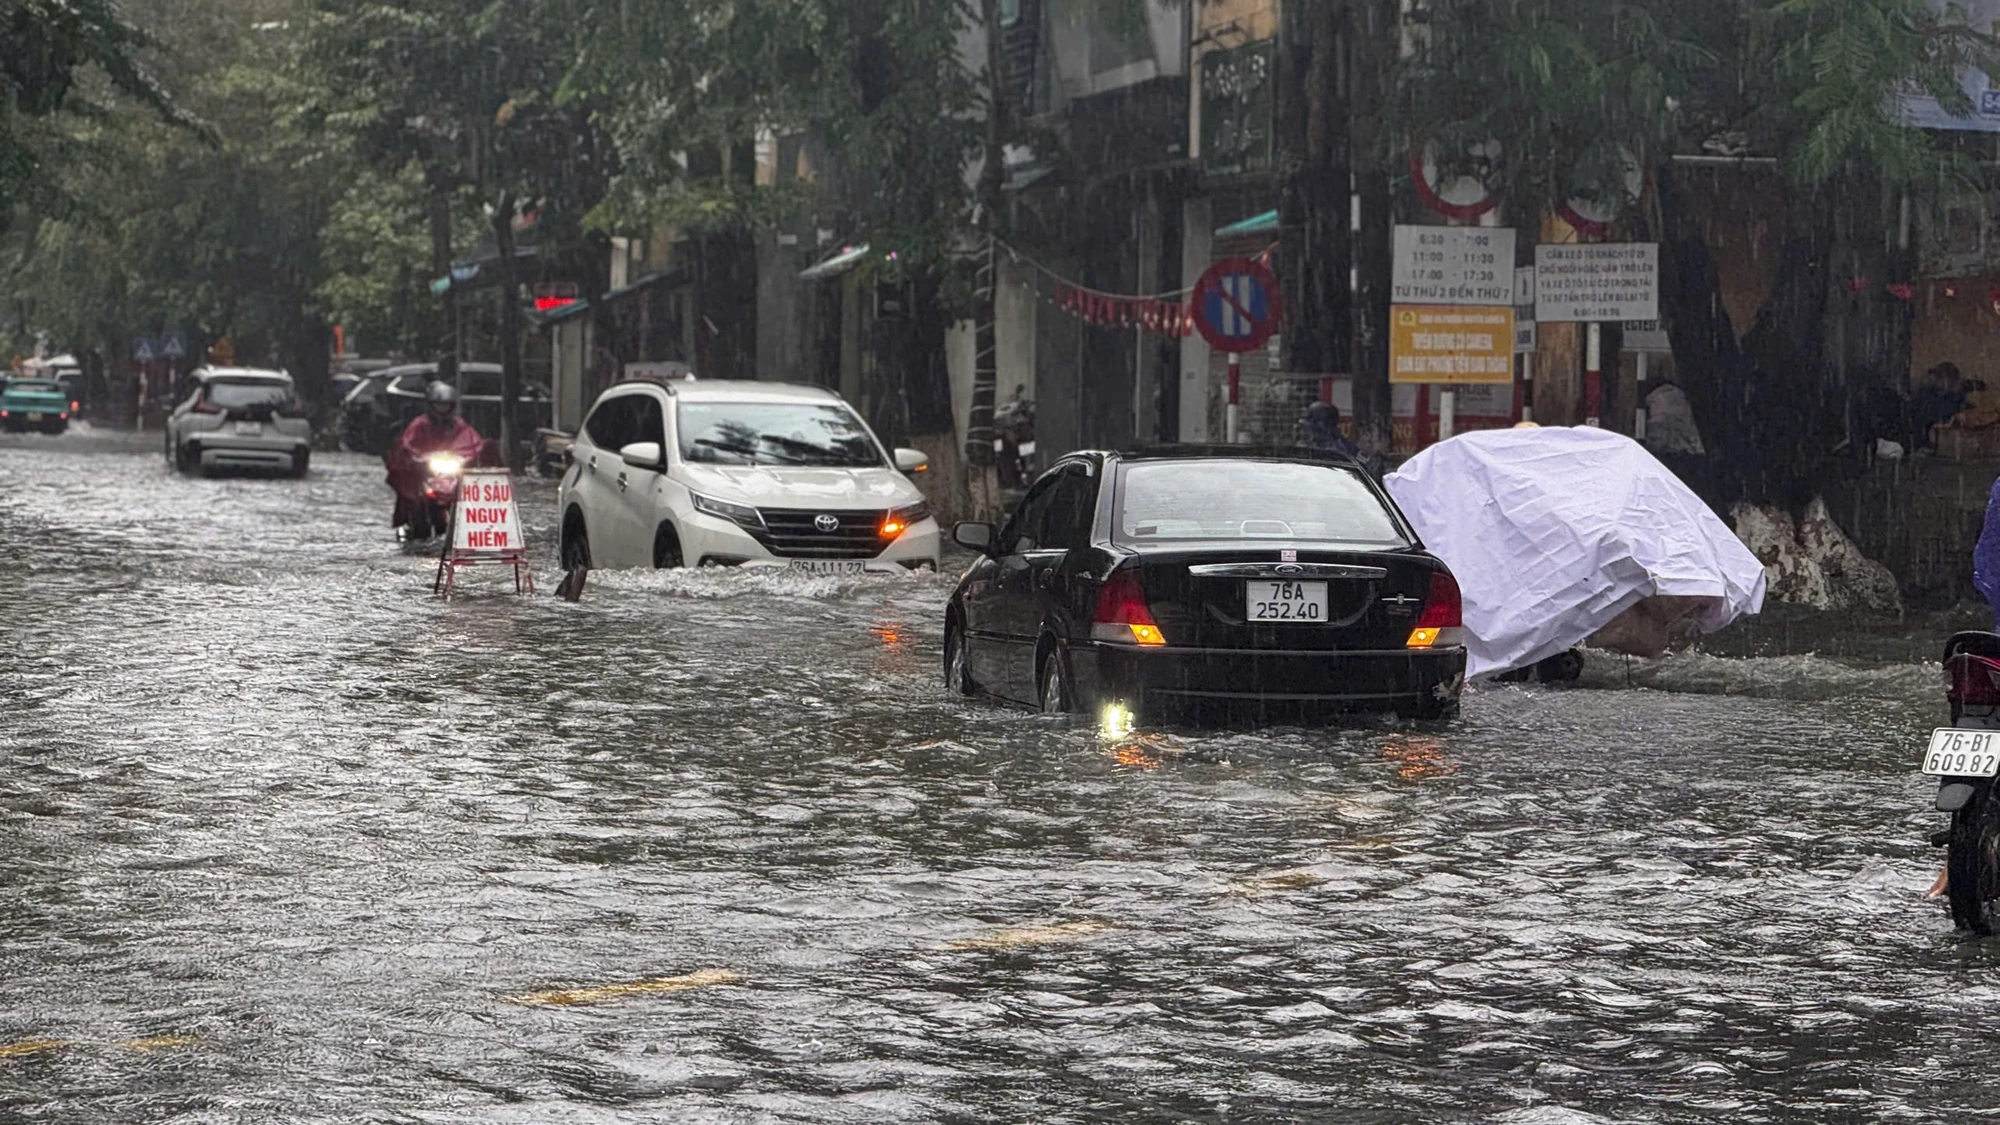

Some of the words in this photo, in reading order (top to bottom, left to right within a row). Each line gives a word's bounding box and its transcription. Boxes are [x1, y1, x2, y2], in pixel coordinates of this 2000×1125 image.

[1413, 252, 1444, 262] 11:00
[1464, 253, 1494, 264] 11:30
[1412, 269, 1443, 280] 17:00
[1464, 271, 1494, 281] 17:30
[1440, 287, 1446, 297] 2
[1503, 289, 1511, 299] 7
[463, 478, 480, 502] HỐ
[484, 480, 509, 502] SÂU
[466, 508, 507, 523] NGUY
[468, 525, 508, 547] HIỂM
[1270, 583, 1304, 600] 76A
[1256, 602, 1318, 620] 252.40
[1941, 733, 1992, 752] 76-B1
[1929, 753, 1995, 774] 609.82
